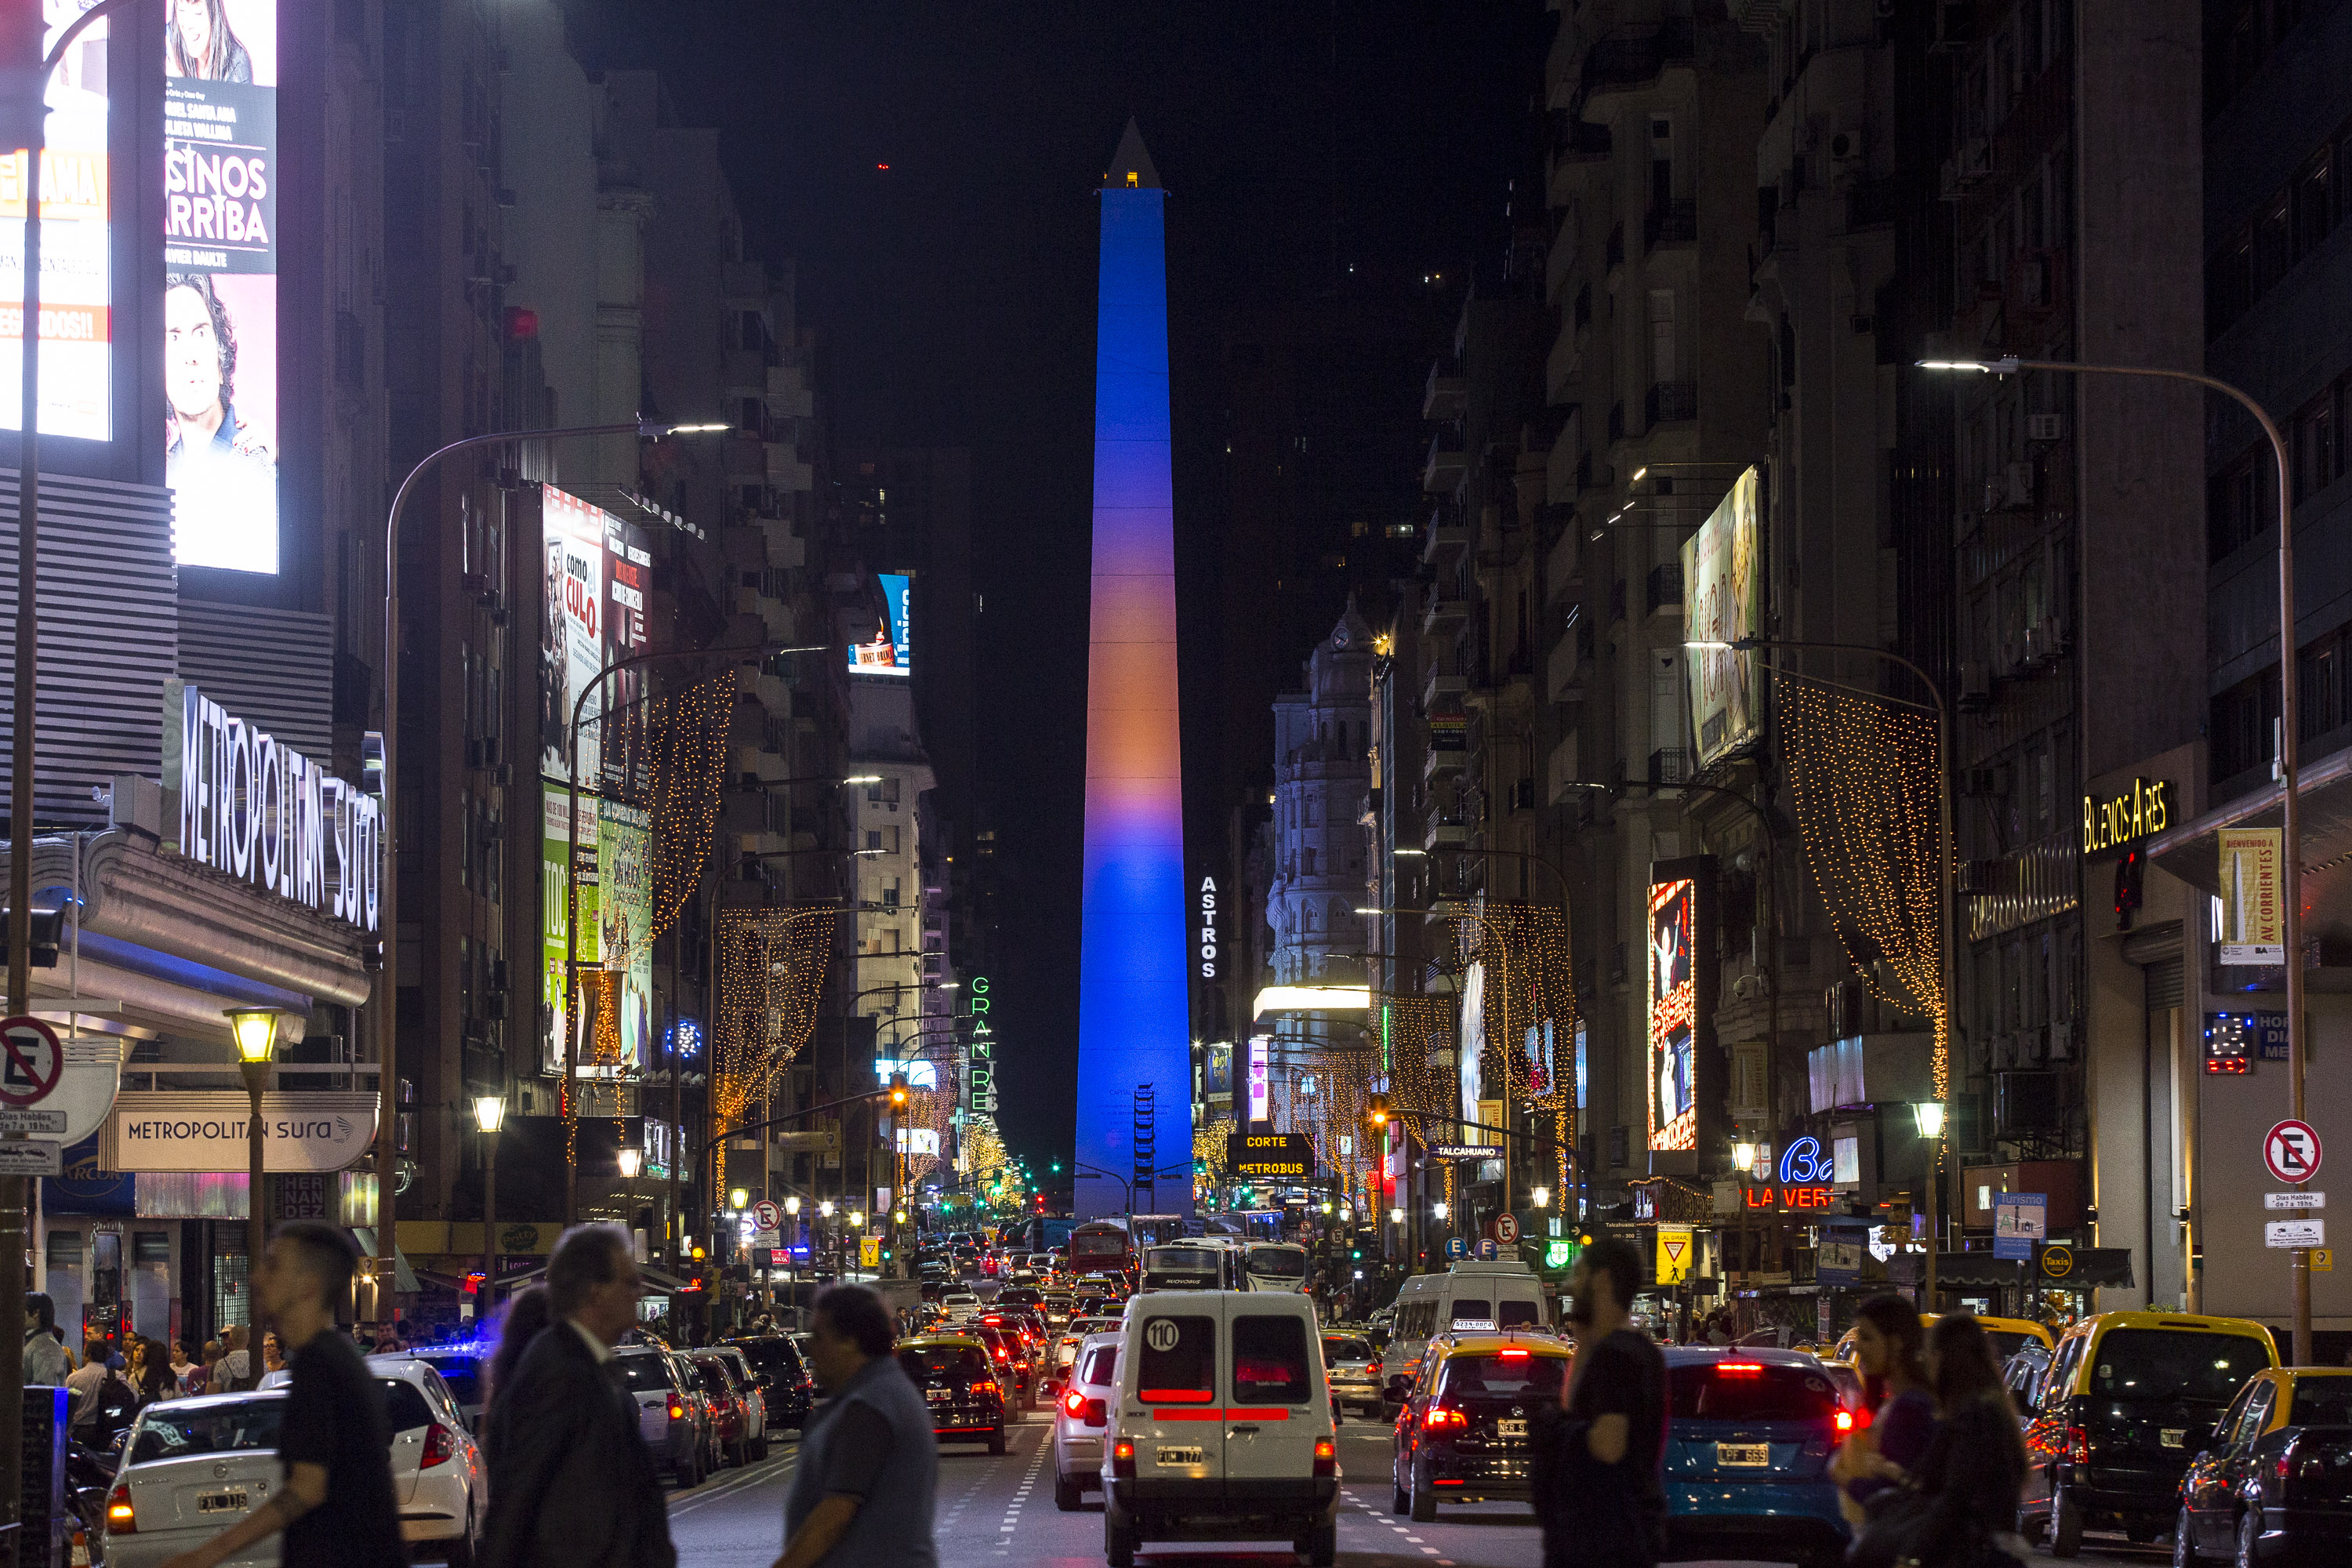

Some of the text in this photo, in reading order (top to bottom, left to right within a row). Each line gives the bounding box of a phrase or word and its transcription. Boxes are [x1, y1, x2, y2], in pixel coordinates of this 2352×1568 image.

[187, 103, 216, 121] SANTA
[193, 250, 227, 268] DAULTE
[566, 553, 587, 583] como
[587, 560, 597, 594] el
[180, 685, 325, 909] METROPOLITAN
[2085, 794, 2129, 854] BUENOS
[2227, 840, 2267, 848] BIENVENIDO
[544, 859, 566, 938] TOC
[2259, 849, 2274, 942] AV. CORRIENTES
[1201, 877, 1217, 978] ASTROS
[972, 977, 990, 1058] GRAN
[985, 1060, 999, 1133] TABA
[129, 1121, 269, 1139] METROPOLITN
[1247, 1137, 1287, 1147] CORTE
[1439, 1147, 1496, 1156] TALCAHUANO
[2283, 1134, 2304, 1169] E
[1239, 1163, 1304, 1174] METROBUS
[285, 1176, 323, 1190] HER
[285, 1191, 323, 1204] NAN
[1748, 1188, 1773, 1207] LA
[2000, 1193, 2043, 1205] Turismo
[285, 1205, 324, 1218] DEZ
[1451, 1240, 1461, 1253] E
[2045, 1257, 2069, 1265] Taxis
[1150, 1323, 1176, 1347] 110
[1500, 1423, 1515, 1432] NER
[1158, 1450, 1201, 1461] FUM 177
[1746, 1450, 1766, 1462] 669
